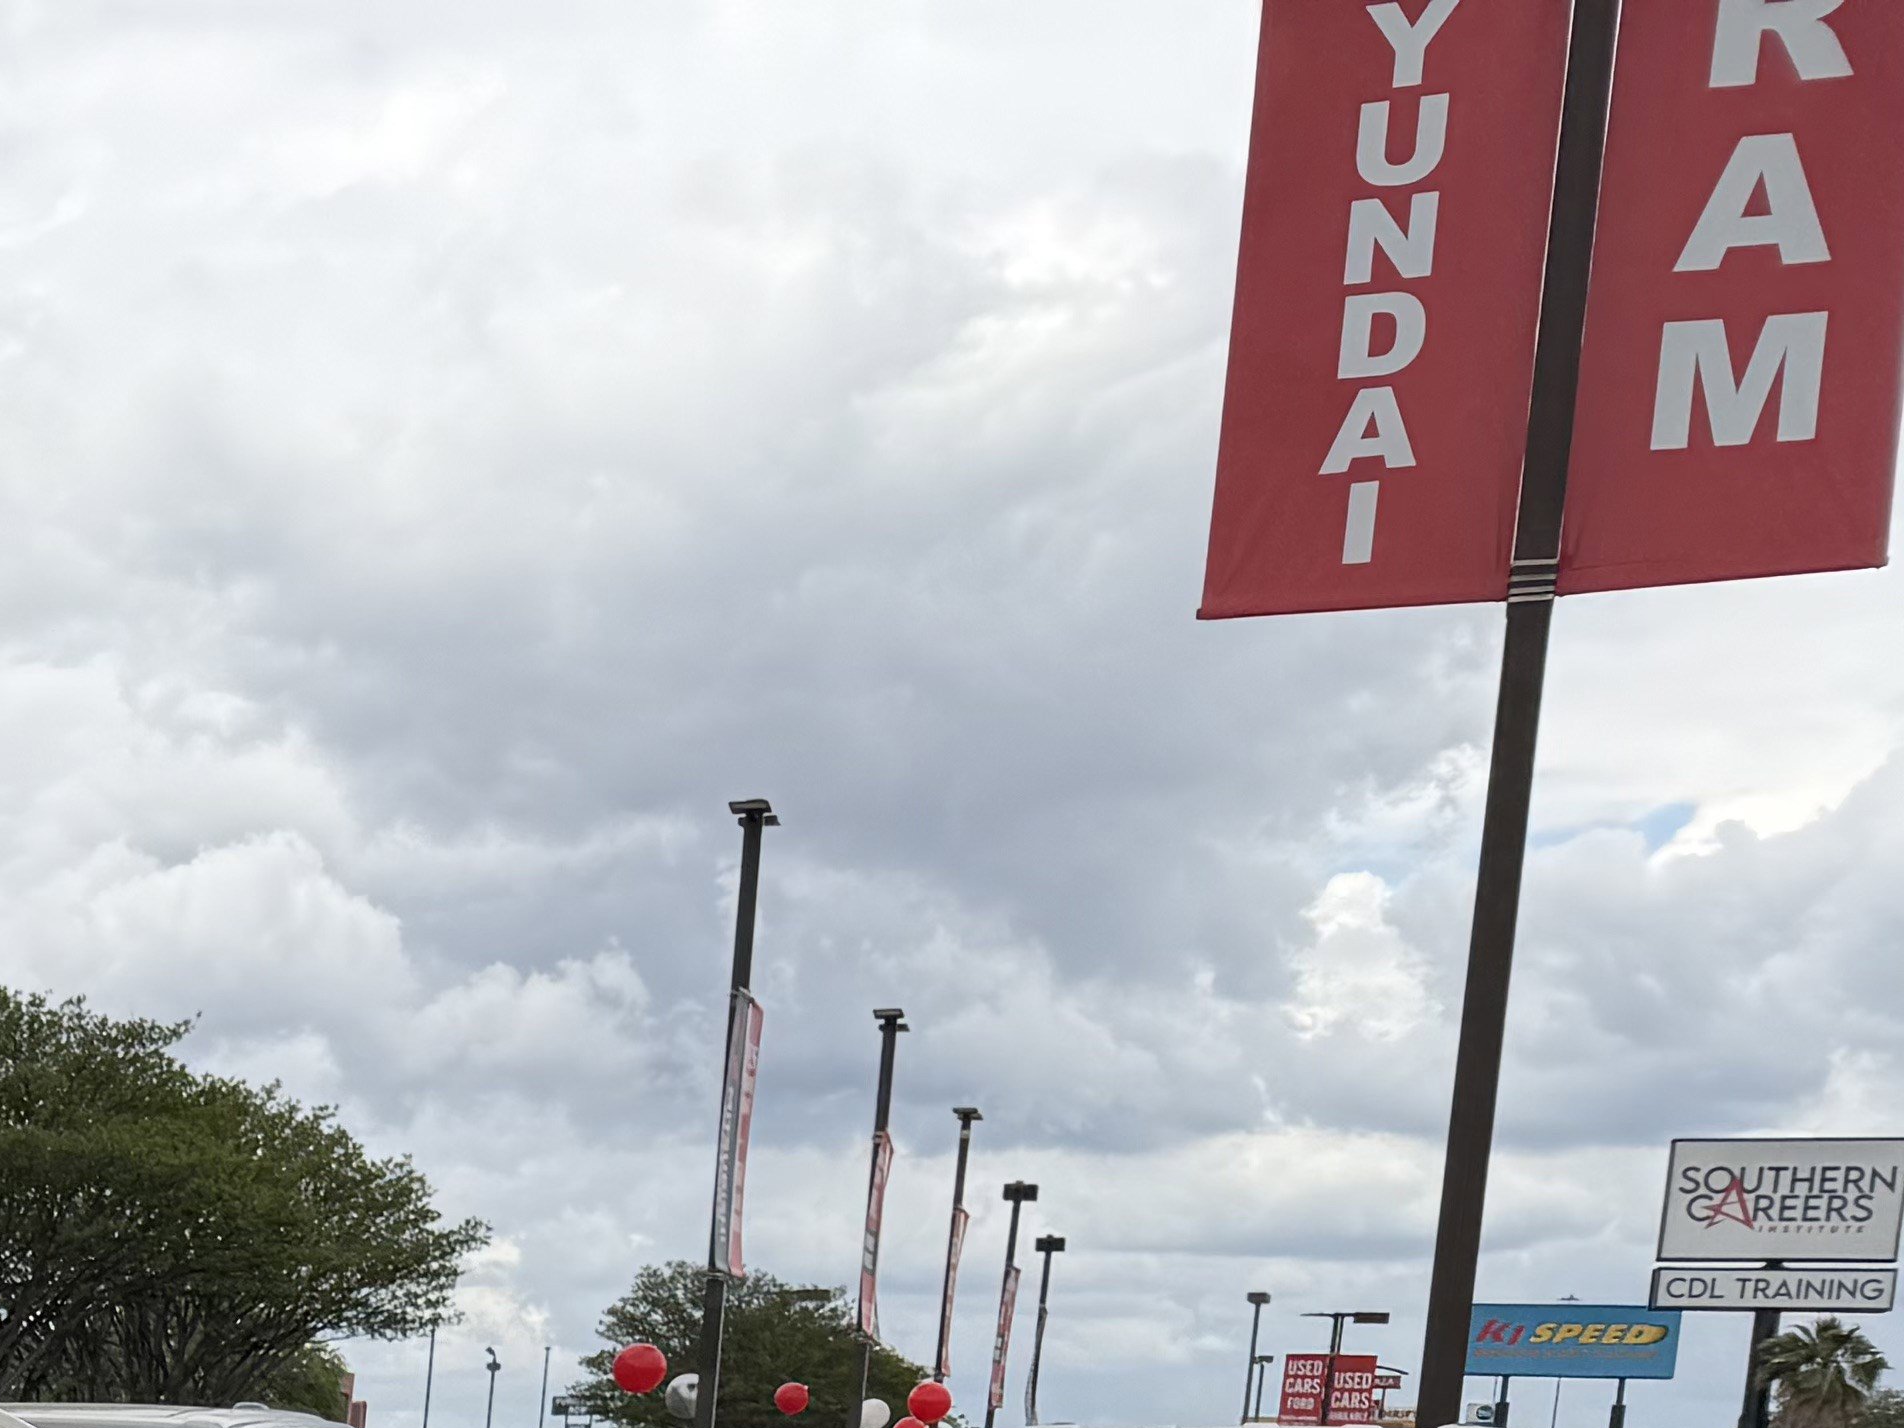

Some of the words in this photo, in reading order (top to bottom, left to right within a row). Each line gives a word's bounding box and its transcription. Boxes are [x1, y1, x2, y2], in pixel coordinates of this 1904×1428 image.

[1650, 0, 1854, 451] RAM
[1678, 1166, 1898, 1194] SOUTHERN
[1687, 1179, 1874, 1229] CAREERS
[1758, 1225, 1867, 1234] INSTITUTE
[1666, 1277, 1724, 1299] CDL
[1735, 1278, 1885, 1301] TRAINING
[1529, 1322, 1669, 1346] SPEED
[1287, 1359, 1323, 1376] USED
[1284, 1378, 1321, 1394] CARS
[1334, 1371, 1372, 1389] USED
[1331, 1391, 1370, 1409] CARS
